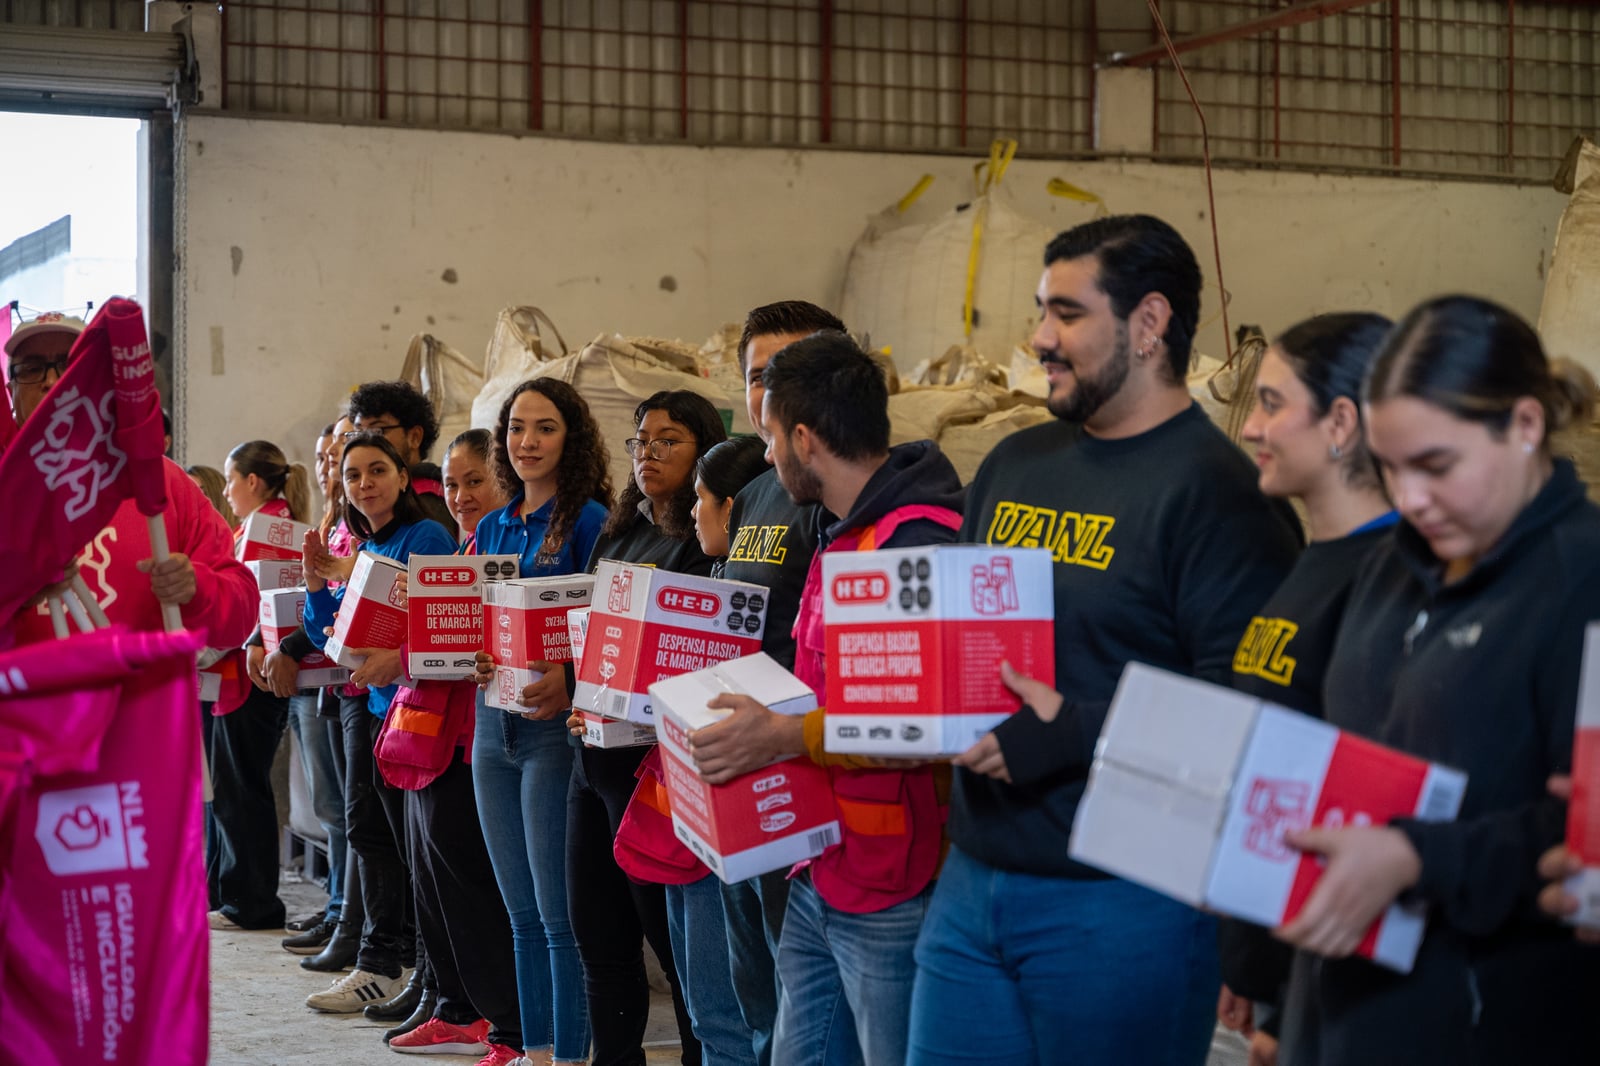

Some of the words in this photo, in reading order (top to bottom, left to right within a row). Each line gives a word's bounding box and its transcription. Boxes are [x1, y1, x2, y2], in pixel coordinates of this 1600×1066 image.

[986, 501, 1115, 570] UANL
[426, 603, 470, 616] DESPENSA
[427, 617, 438, 629] DE
[439, 617, 471, 629] MARCA
[545, 616, 566, 627] PIEZAS
[430, 634, 468, 644] CONTENIDO
[469, 634, 476, 644] 12
[658, 633, 706, 655] DESPENSA
[707, 640, 741, 660] BASICA
[655, 650, 669, 667] DE
[669, 651, 704, 671] MARCA
[1232, 616, 1299, 687] ANL
[90, 885, 109, 904] E
[114, 883, 134, 1022] IGUALDAD
[93, 911, 121, 1060] INCLUSIÓN
